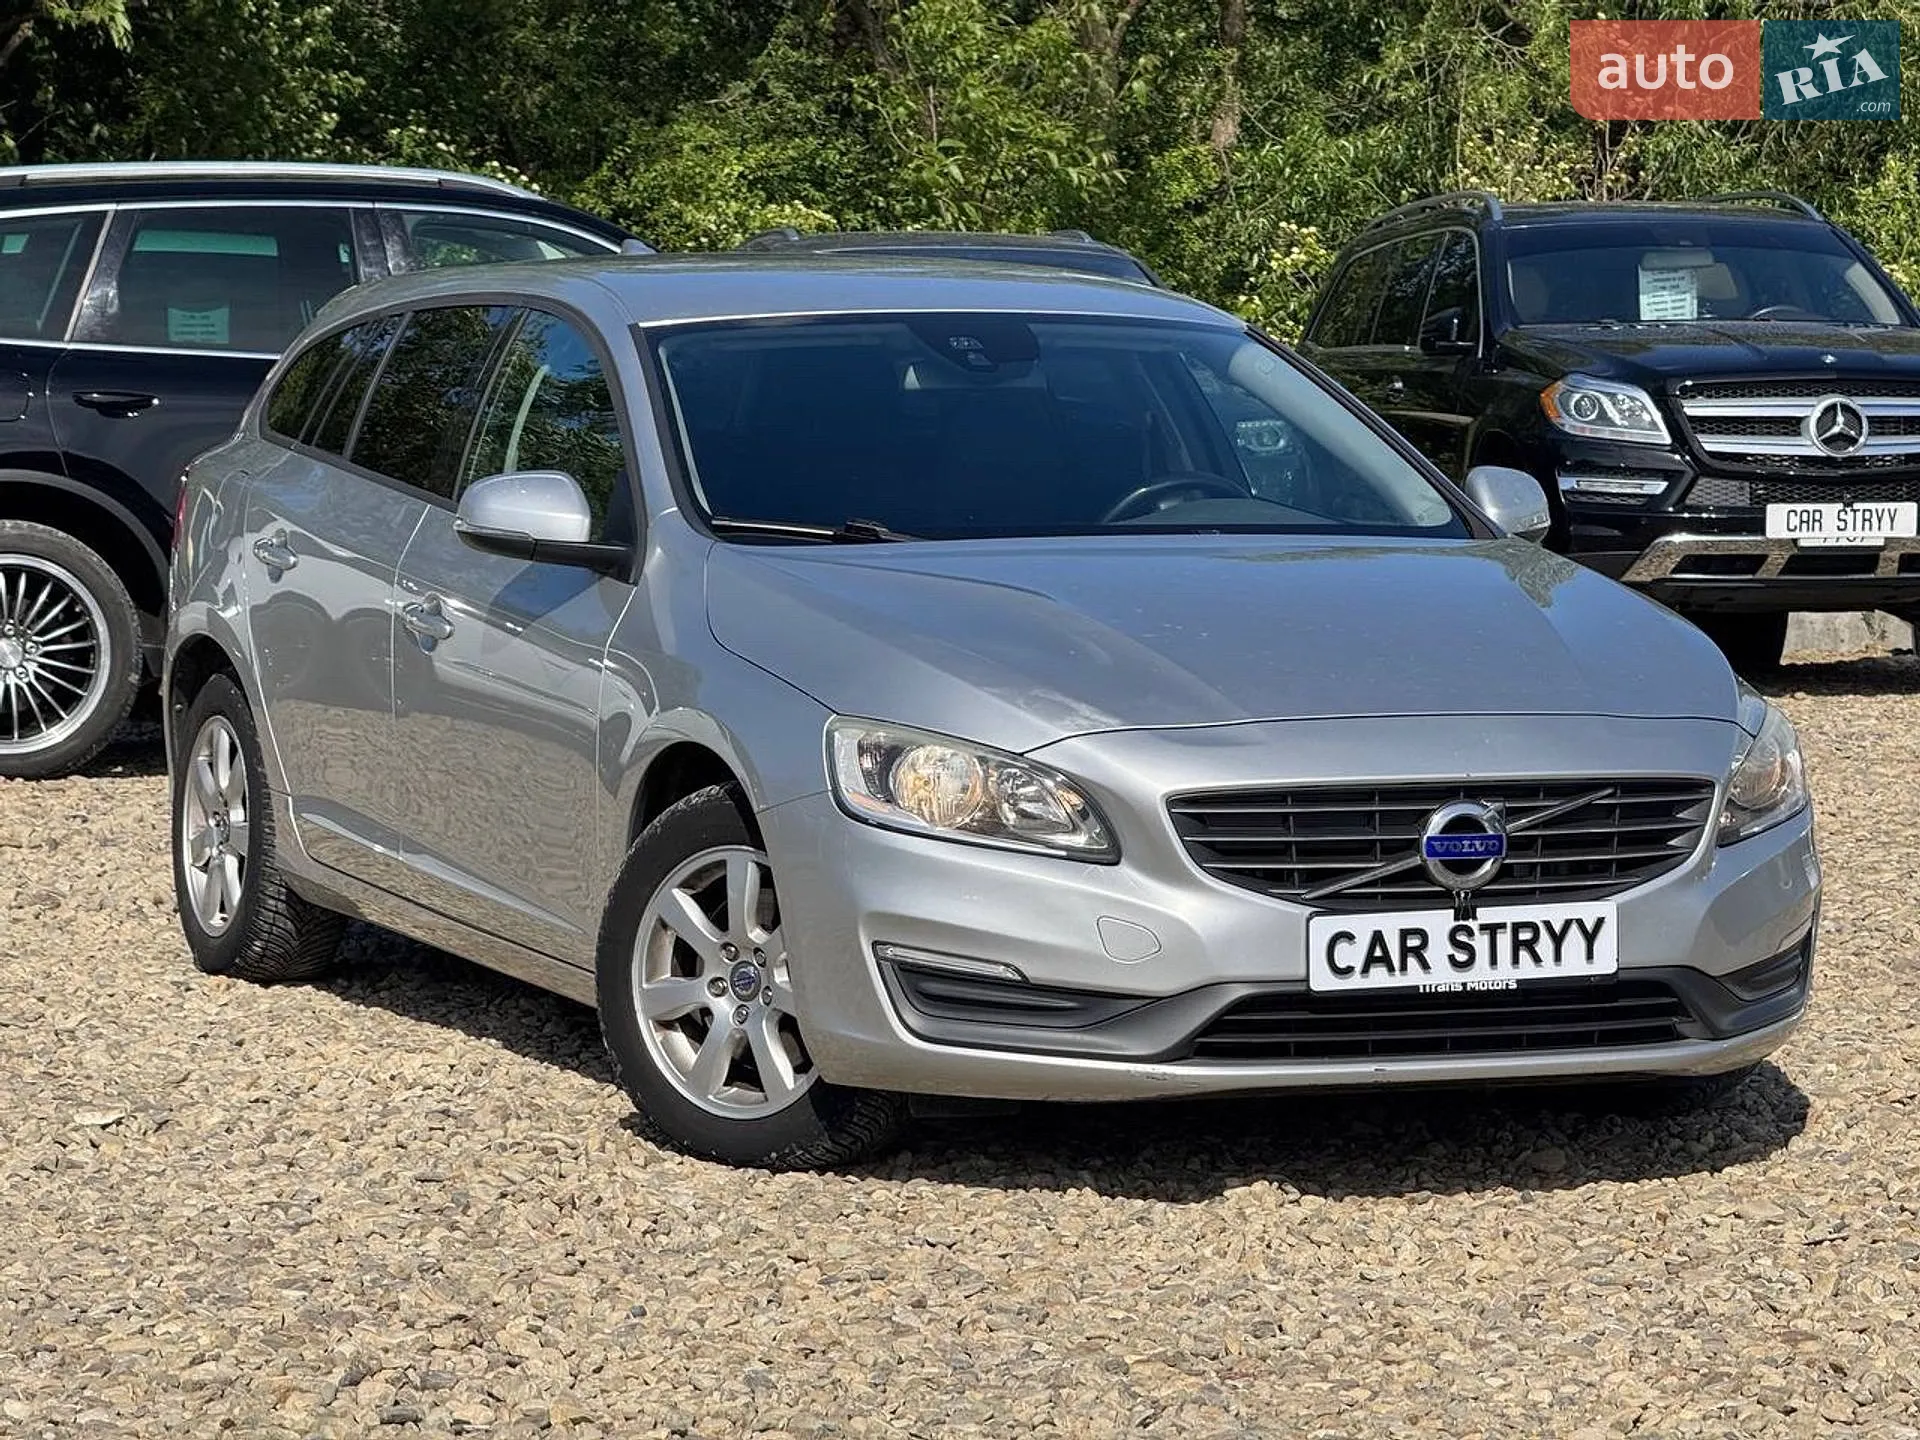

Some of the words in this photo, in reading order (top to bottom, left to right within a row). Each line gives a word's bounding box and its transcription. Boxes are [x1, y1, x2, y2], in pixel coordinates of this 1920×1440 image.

[1786, 509, 1823, 532] CAR
[1836, 508, 1897, 532] STRYY
[1430, 840, 1500, 853] VOLVO
[1326, 928, 1431, 976] CAR
[1448, 916, 1606, 970] STRYY
